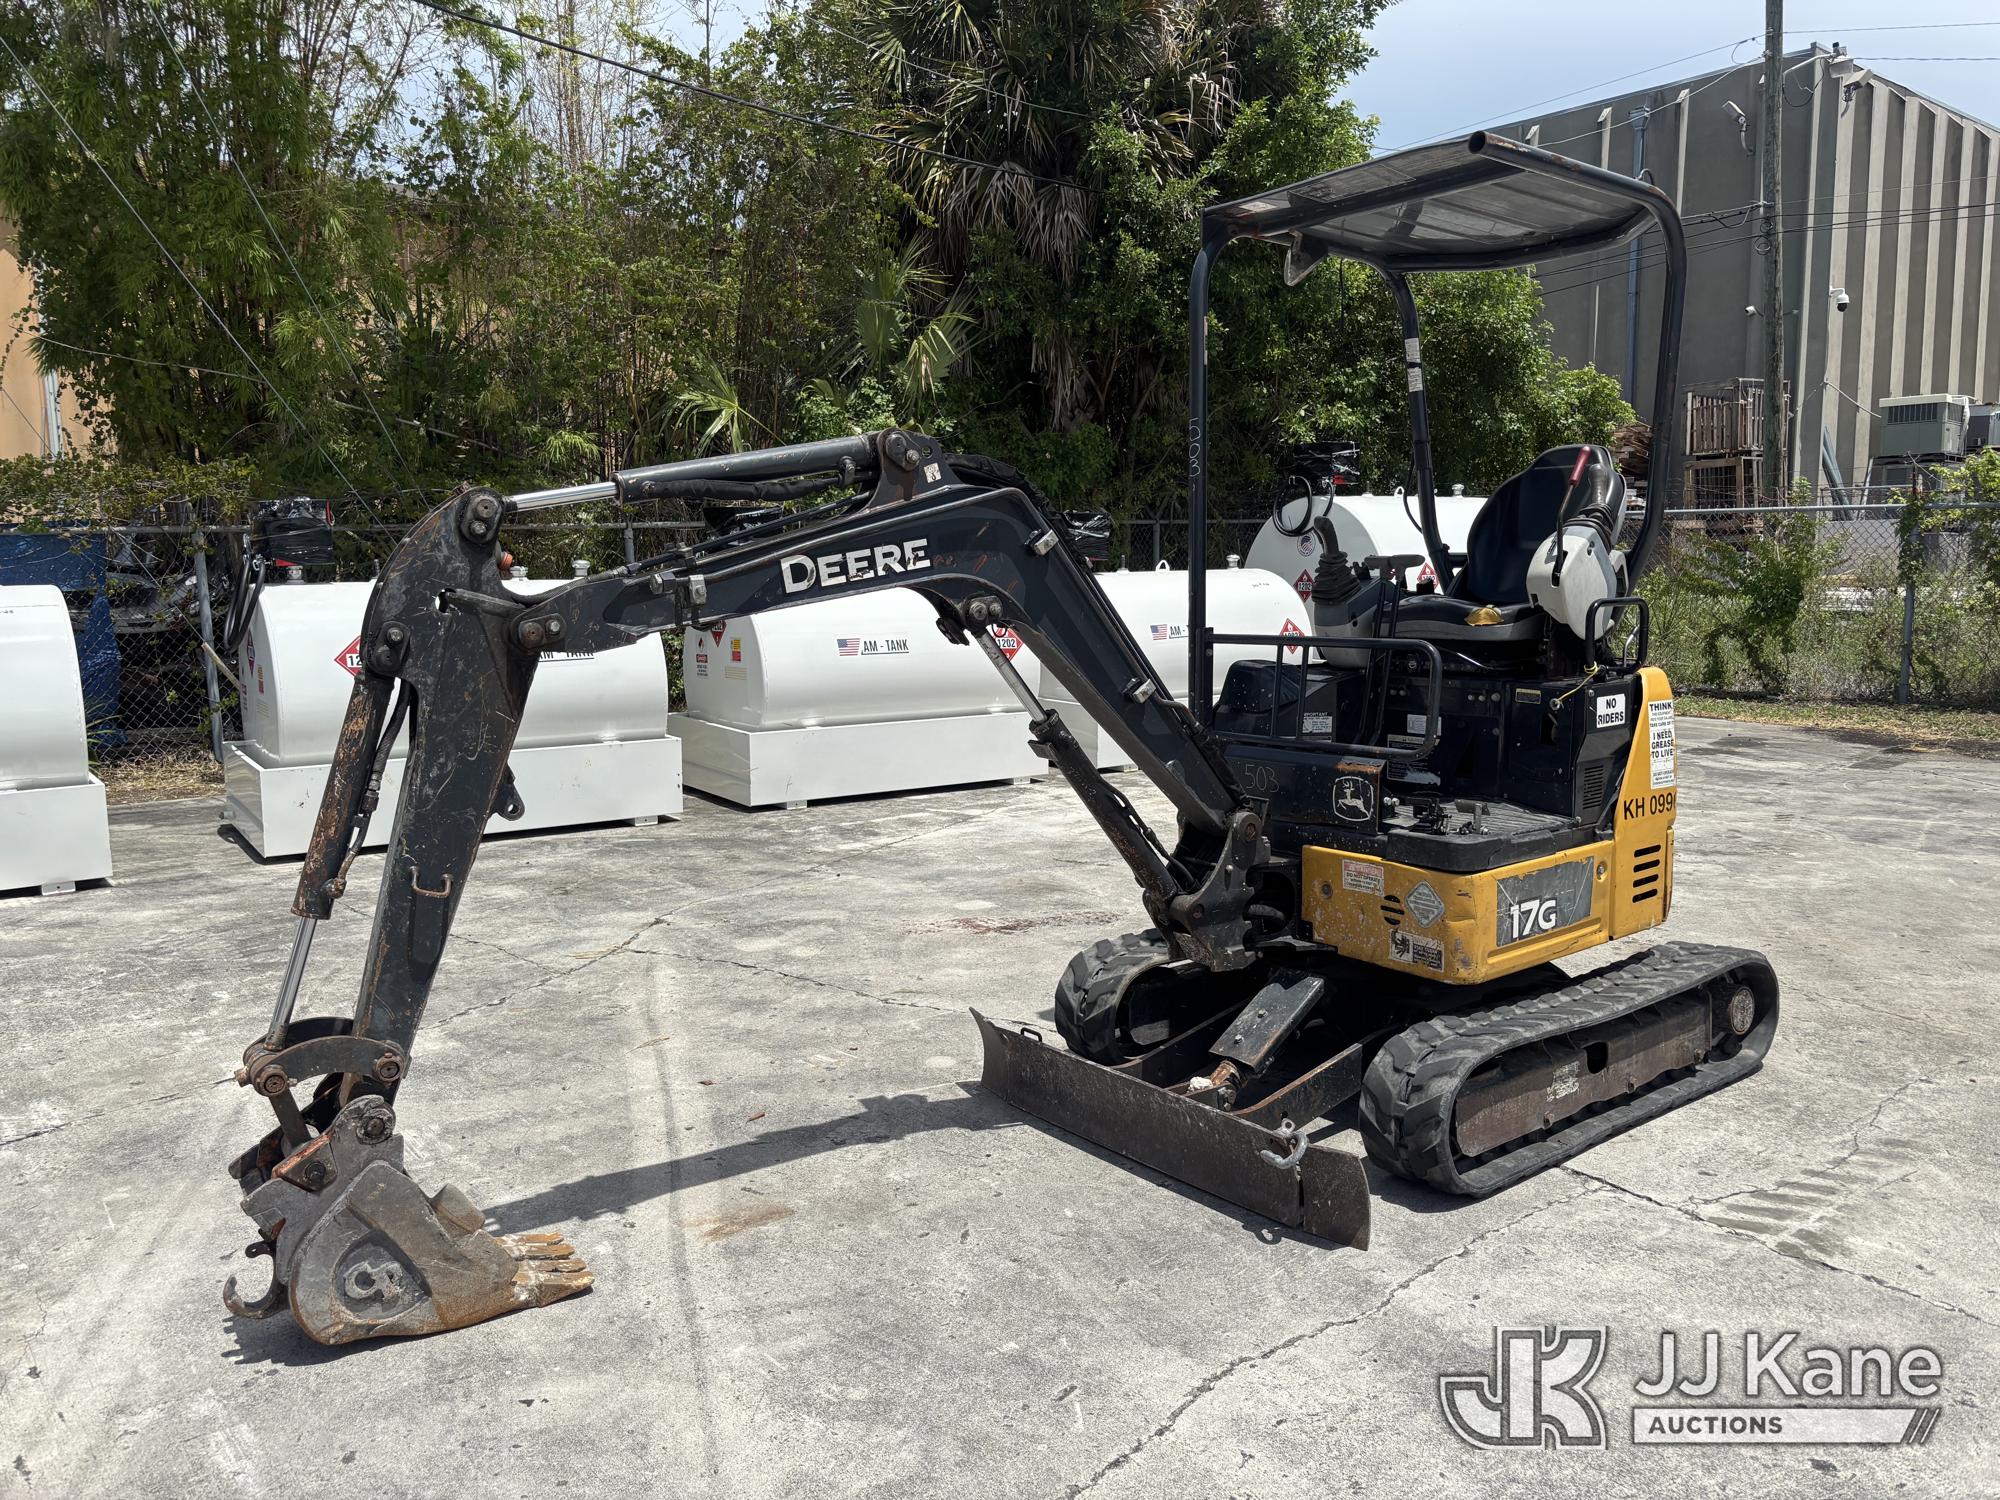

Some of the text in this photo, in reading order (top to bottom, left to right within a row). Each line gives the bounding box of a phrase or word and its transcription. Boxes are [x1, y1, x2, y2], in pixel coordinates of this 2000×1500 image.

[780, 538, 931, 594] DEERE
[1169, 626, 1182, 636] AM
[863, 640, 878, 652] AM
[886, 639, 909, 651] TANK
[997, 638, 1016, 648] 1202
[1606, 698, 1617, 709] NO
[1649, 702, 1673, 712] THINK
[1597, 711, 1624, 725] RIDERS
[1657, 731, 1672, 740] NEED
[1651, 739, 1674, 749] GREASE
[1651, 749, 1673, 759] TO LIVE
[1245, 763, 1280, 792] 503
[1623, 791, 1676, 820] KH 099
[1510, 899, 1556, 938] 17G
